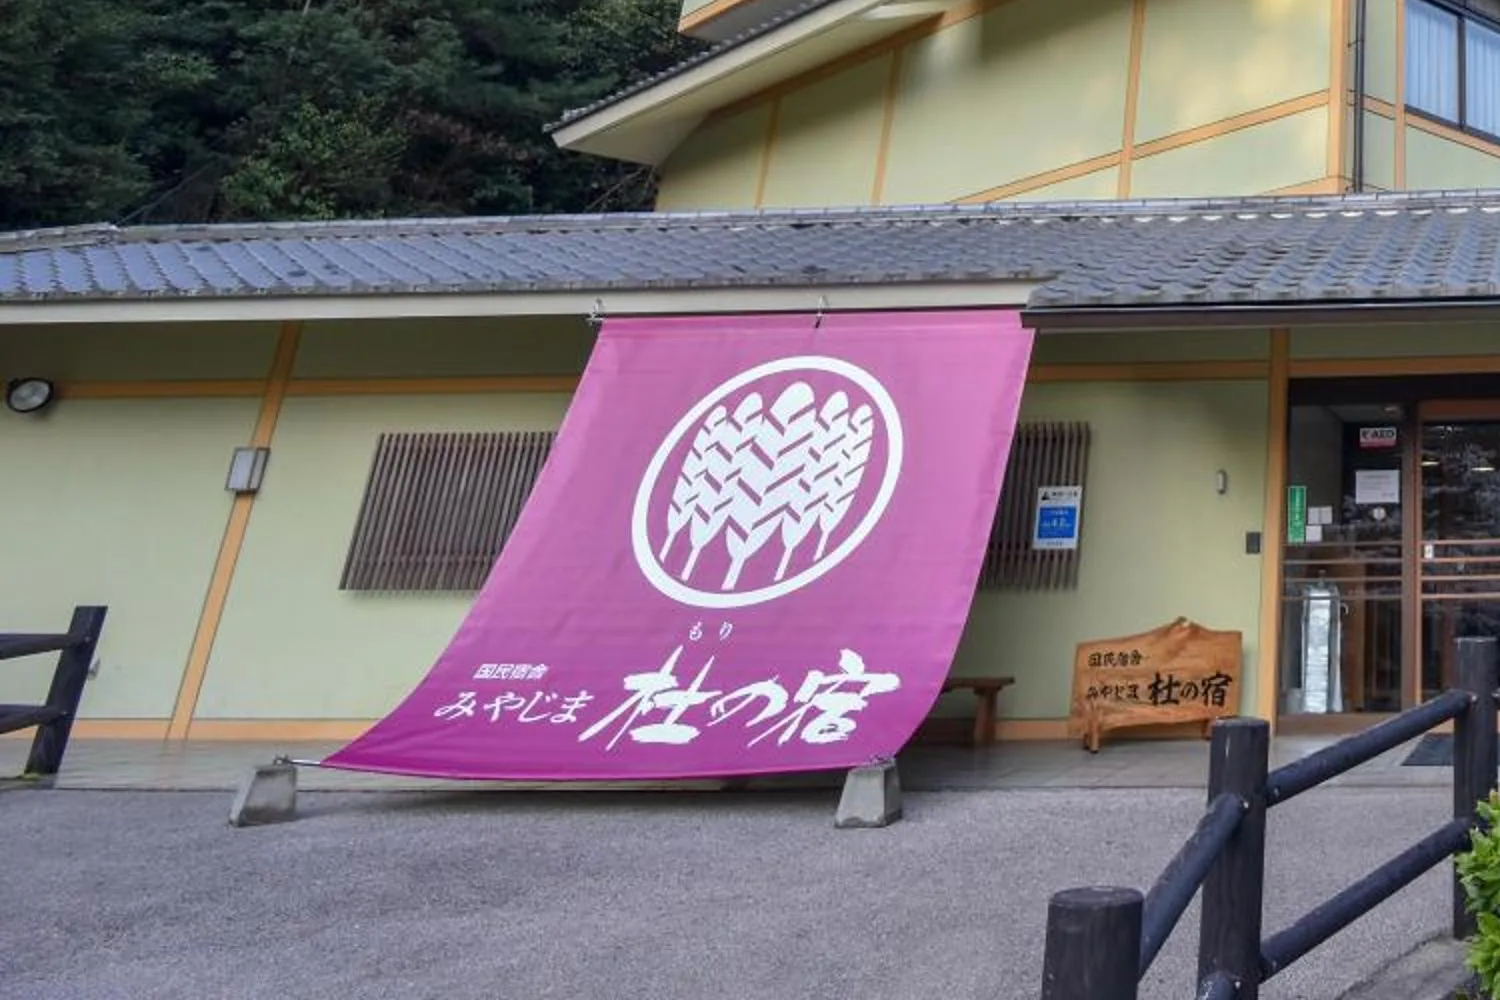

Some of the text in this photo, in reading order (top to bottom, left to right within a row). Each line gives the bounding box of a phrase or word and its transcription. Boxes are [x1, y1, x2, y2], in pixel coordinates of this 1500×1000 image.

[689, 621, 733, 641] もり
[473, 663, 549, 680] 国民宿舎
[434, 645, 901, 751] みやじま 杜の宿
[1148, 671, 1233, 707] 杜の宿
